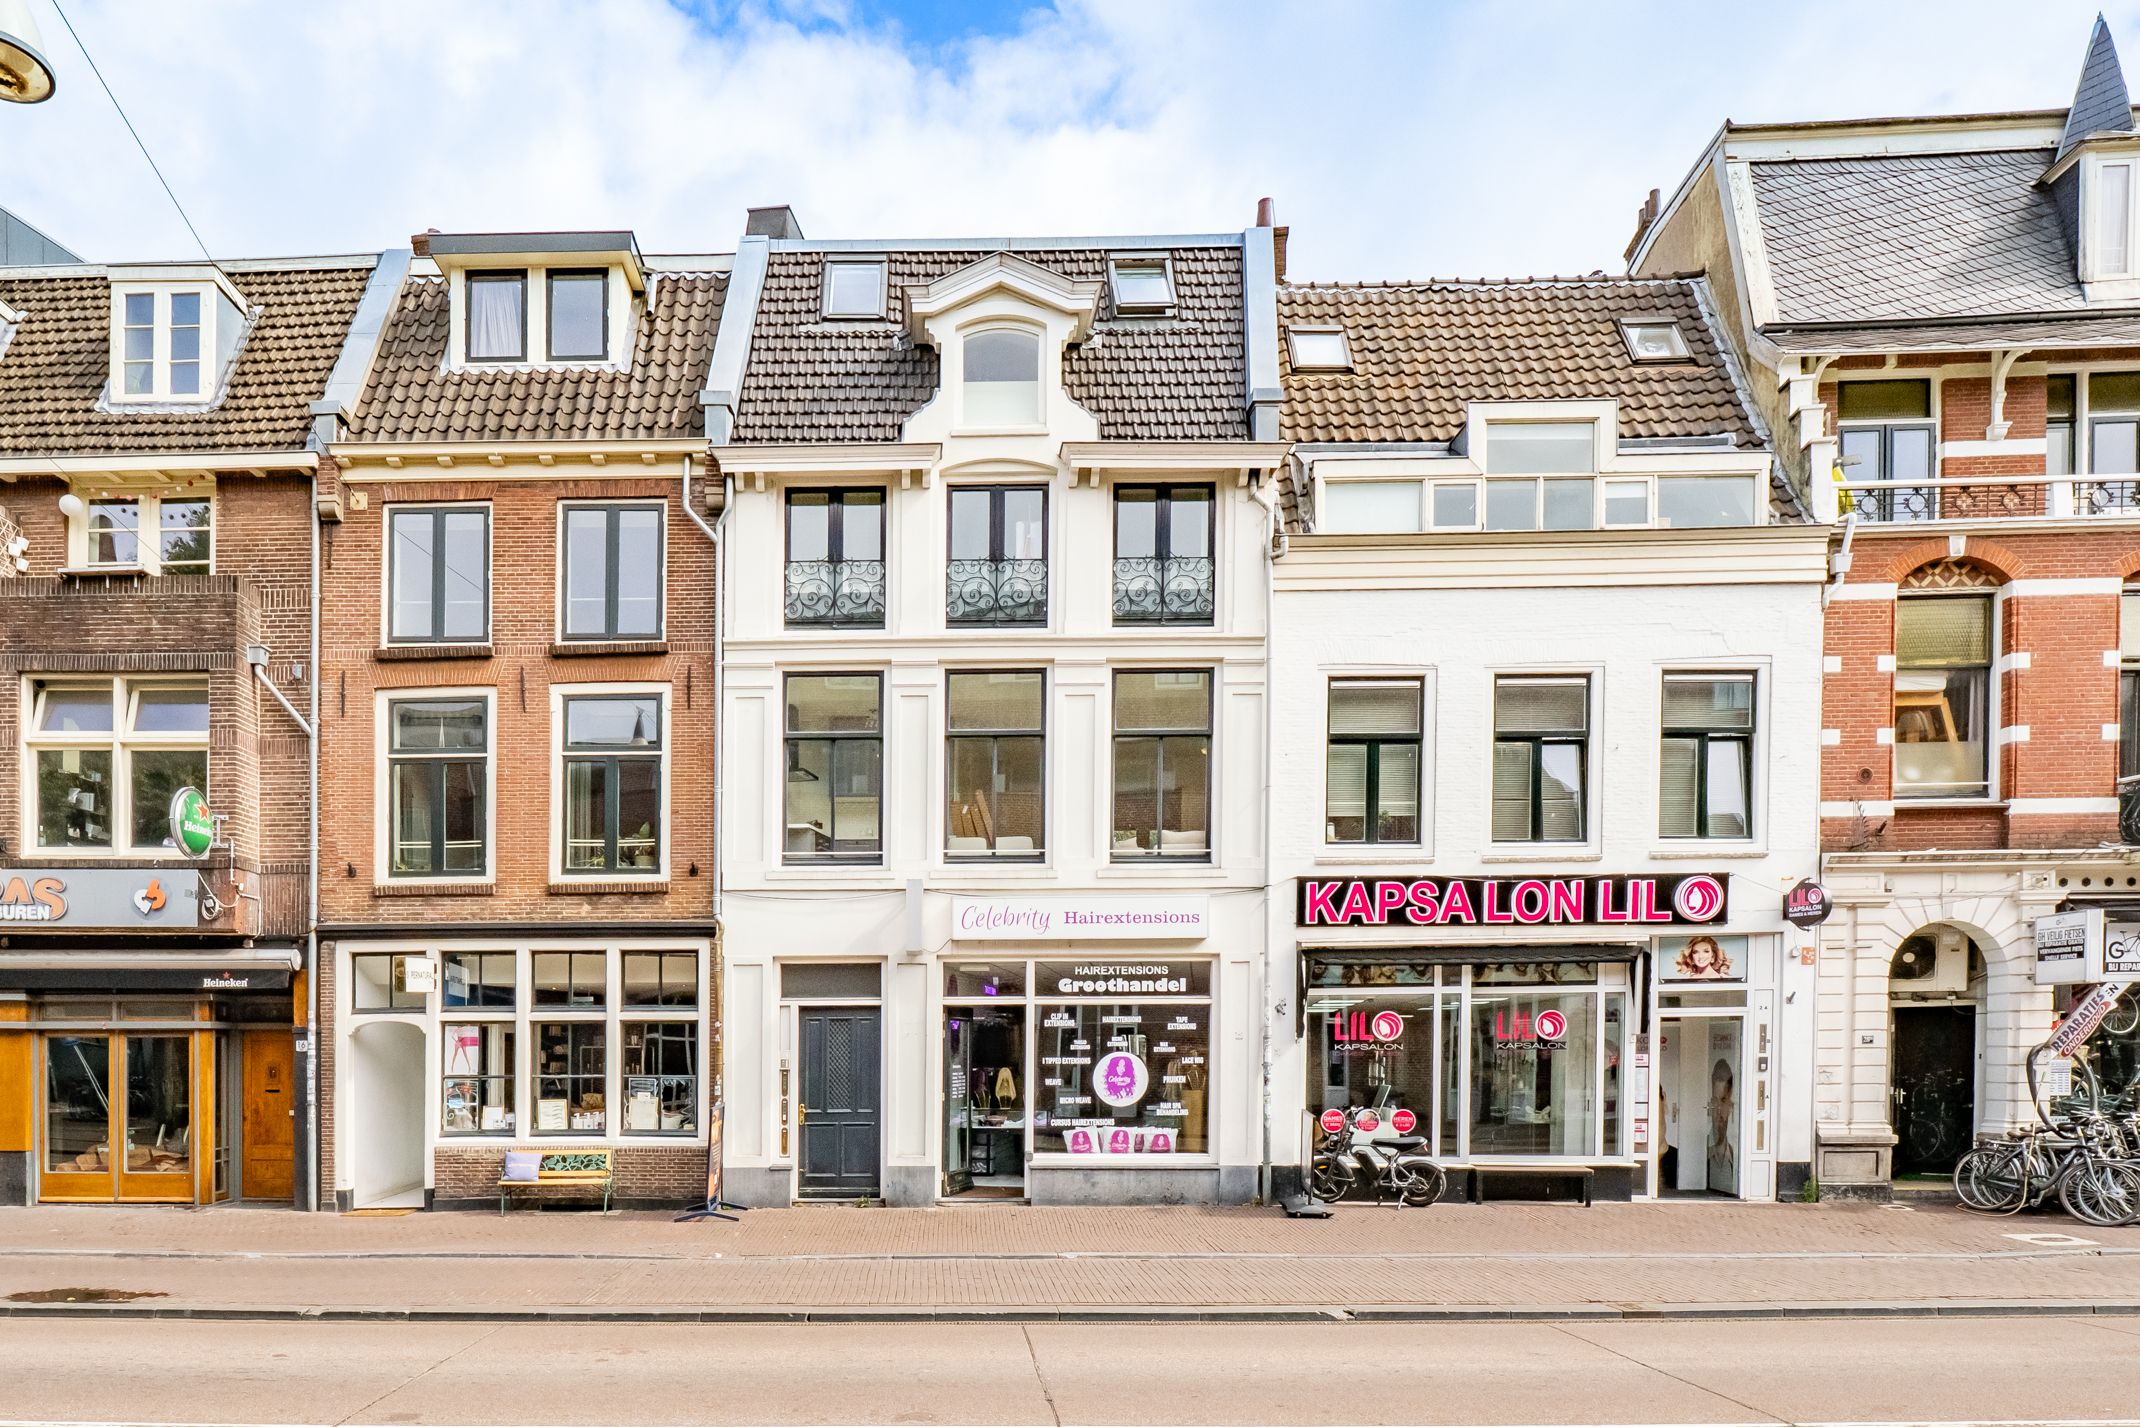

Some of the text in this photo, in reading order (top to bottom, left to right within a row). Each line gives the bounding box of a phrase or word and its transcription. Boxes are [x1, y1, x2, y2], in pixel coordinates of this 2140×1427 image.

[0, 876, 69, 920] AS
[1305, 880, 1584, 924] KAPSALON
[0, 904, 51, 920] UREN
[1789, 904, 1822, 912] KAPSALON
[961, 905, 1200, 935] Celebrity Hairextensions
[2037, 927, 2085, 941] GH VEILIG FIETSEN
[1074, 965, 1169, 976] HAIREXTENSIONS
[2108, 962, 2119, 971] BIJ
[203, 977, 248, 988] Heineken
[1058, 977, 1187, 993] Groothandel
[1050, 1012, 1062, 1020] CLIP
[1102, 1015, 1141, 1023] HAIREXTENSIONS
[1044, 1019, 1075, 1027] EXTENSIONS
[2051, 990, 2105, 1052] REPARATIES
[1167, 1022, 1197, 1030] EXTENSIONS
[2063, 1004, 2106, 1055] ONDERHOUD
[1334, 1043, 1404, 1051] KAPSALON
[1496, 1042, 1568, 1050] KAPSALON
[1045, 1057, 1062, 1065] TIPPED
[1062, 1057, 1091, 1065] EXTENSIONS
[1181, 1056, 1194, 1065] LACE
[1044, 1078, 1062, 1086] WEAVE
[1162, 1075, 1187, 1084] PRUIKEN
[1060, 1096, 1092, 1105] MICRO WEAVE
[1160, 1101, 1182, 1109] HAIR SPA
[1050, 1118, 1115, 1127] CURSUS HAIREXTENSIONS
